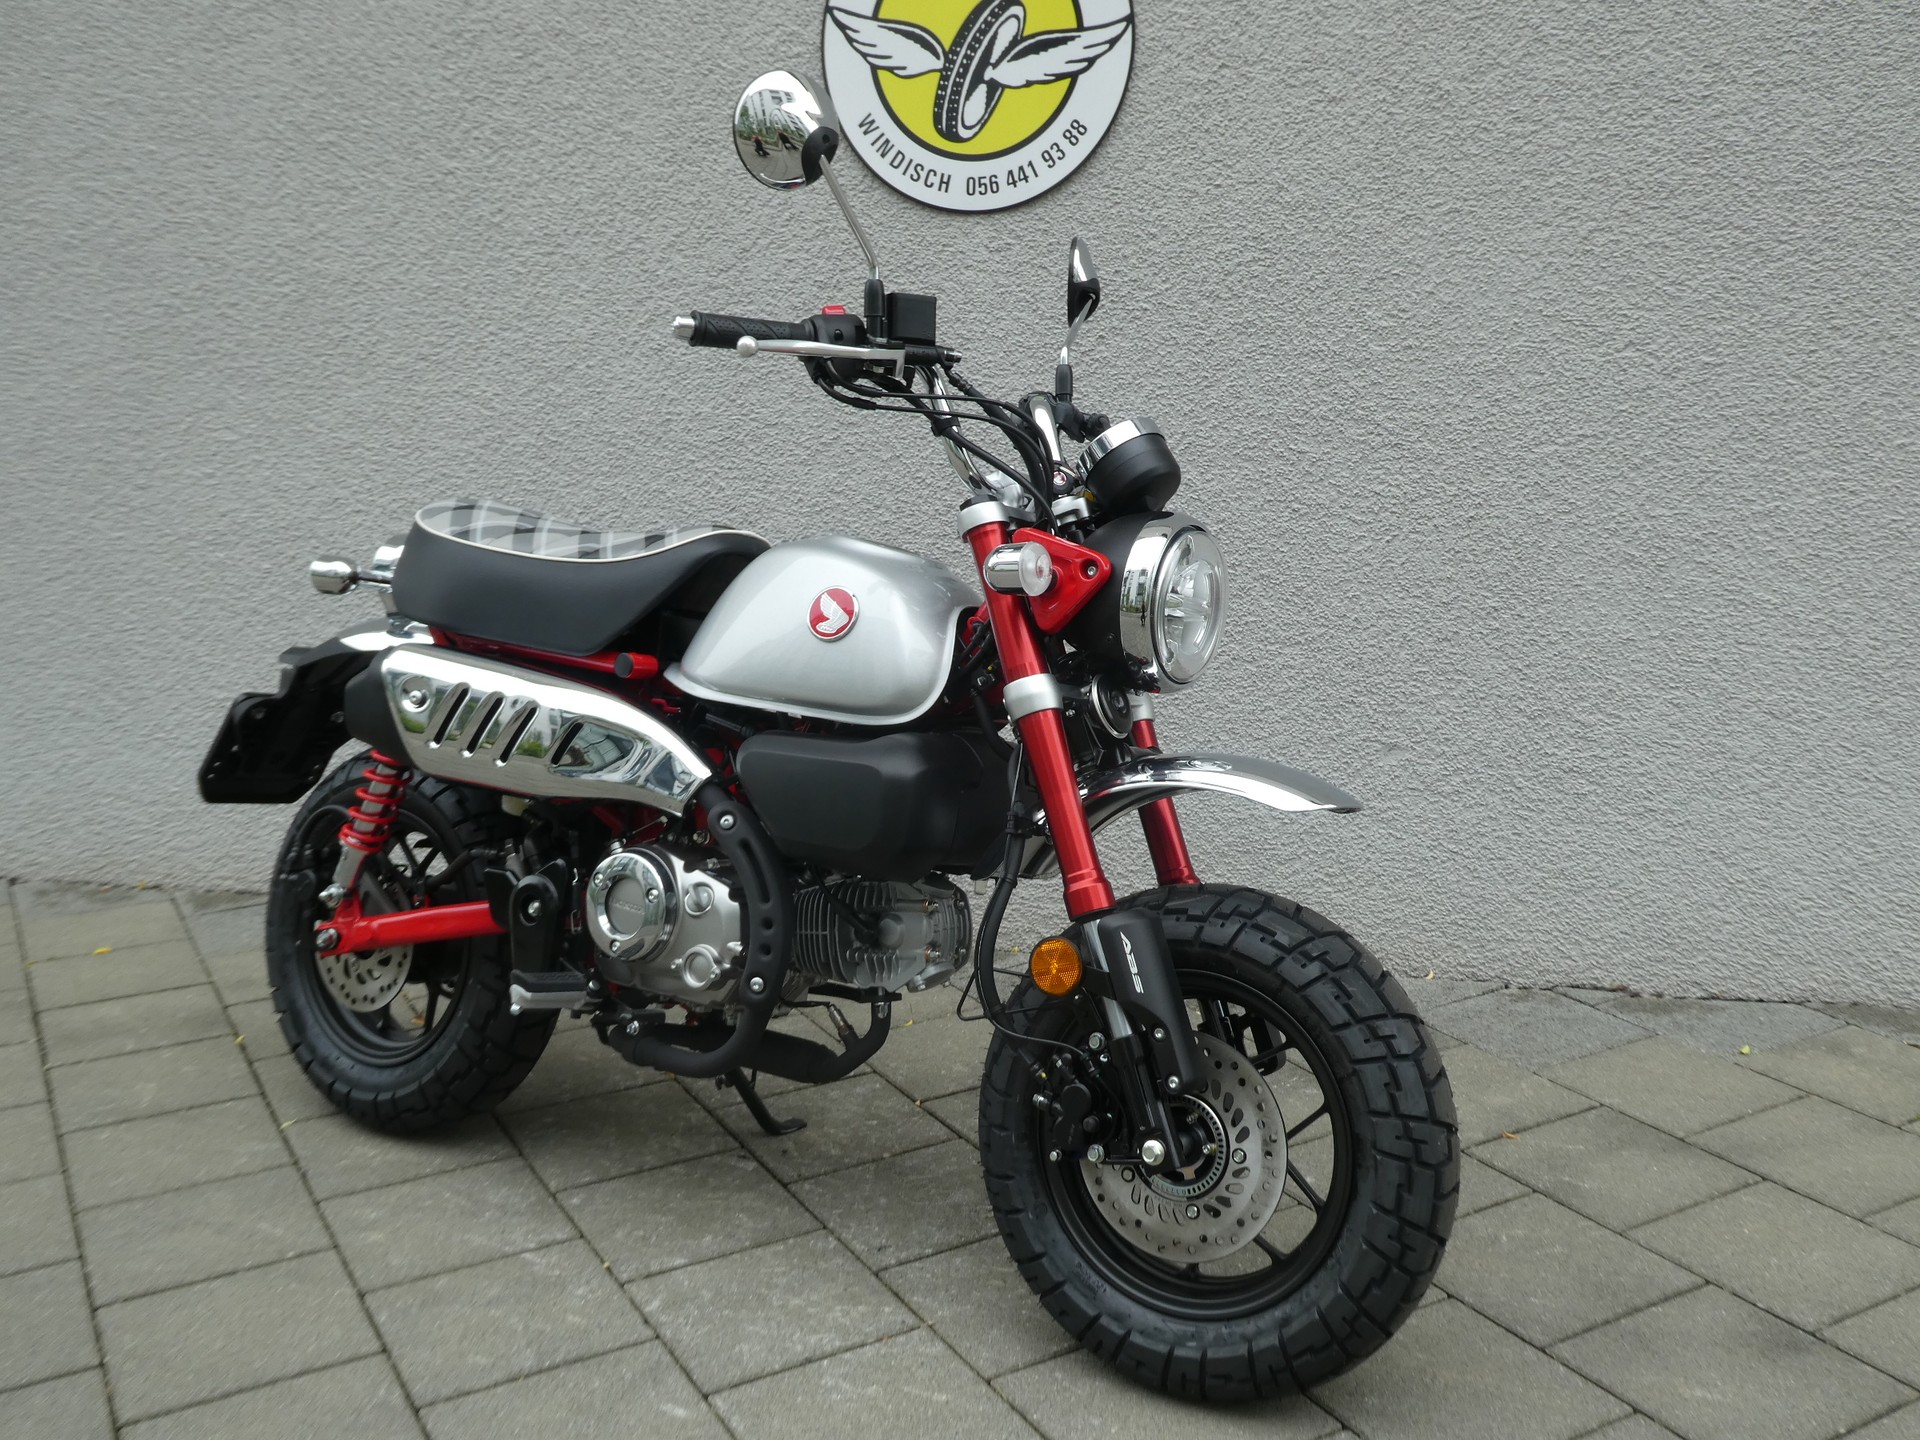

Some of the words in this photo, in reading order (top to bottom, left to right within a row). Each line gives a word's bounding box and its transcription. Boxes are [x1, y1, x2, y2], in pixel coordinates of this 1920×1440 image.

[857, 112, 952, 194] WINDISCH
[966, 175, 1000, 197] 056
[1006, 160, 1039, 188] 441
[1041, 142, 1067, 170] 93
[1062, 118, 1088, 147] 88
